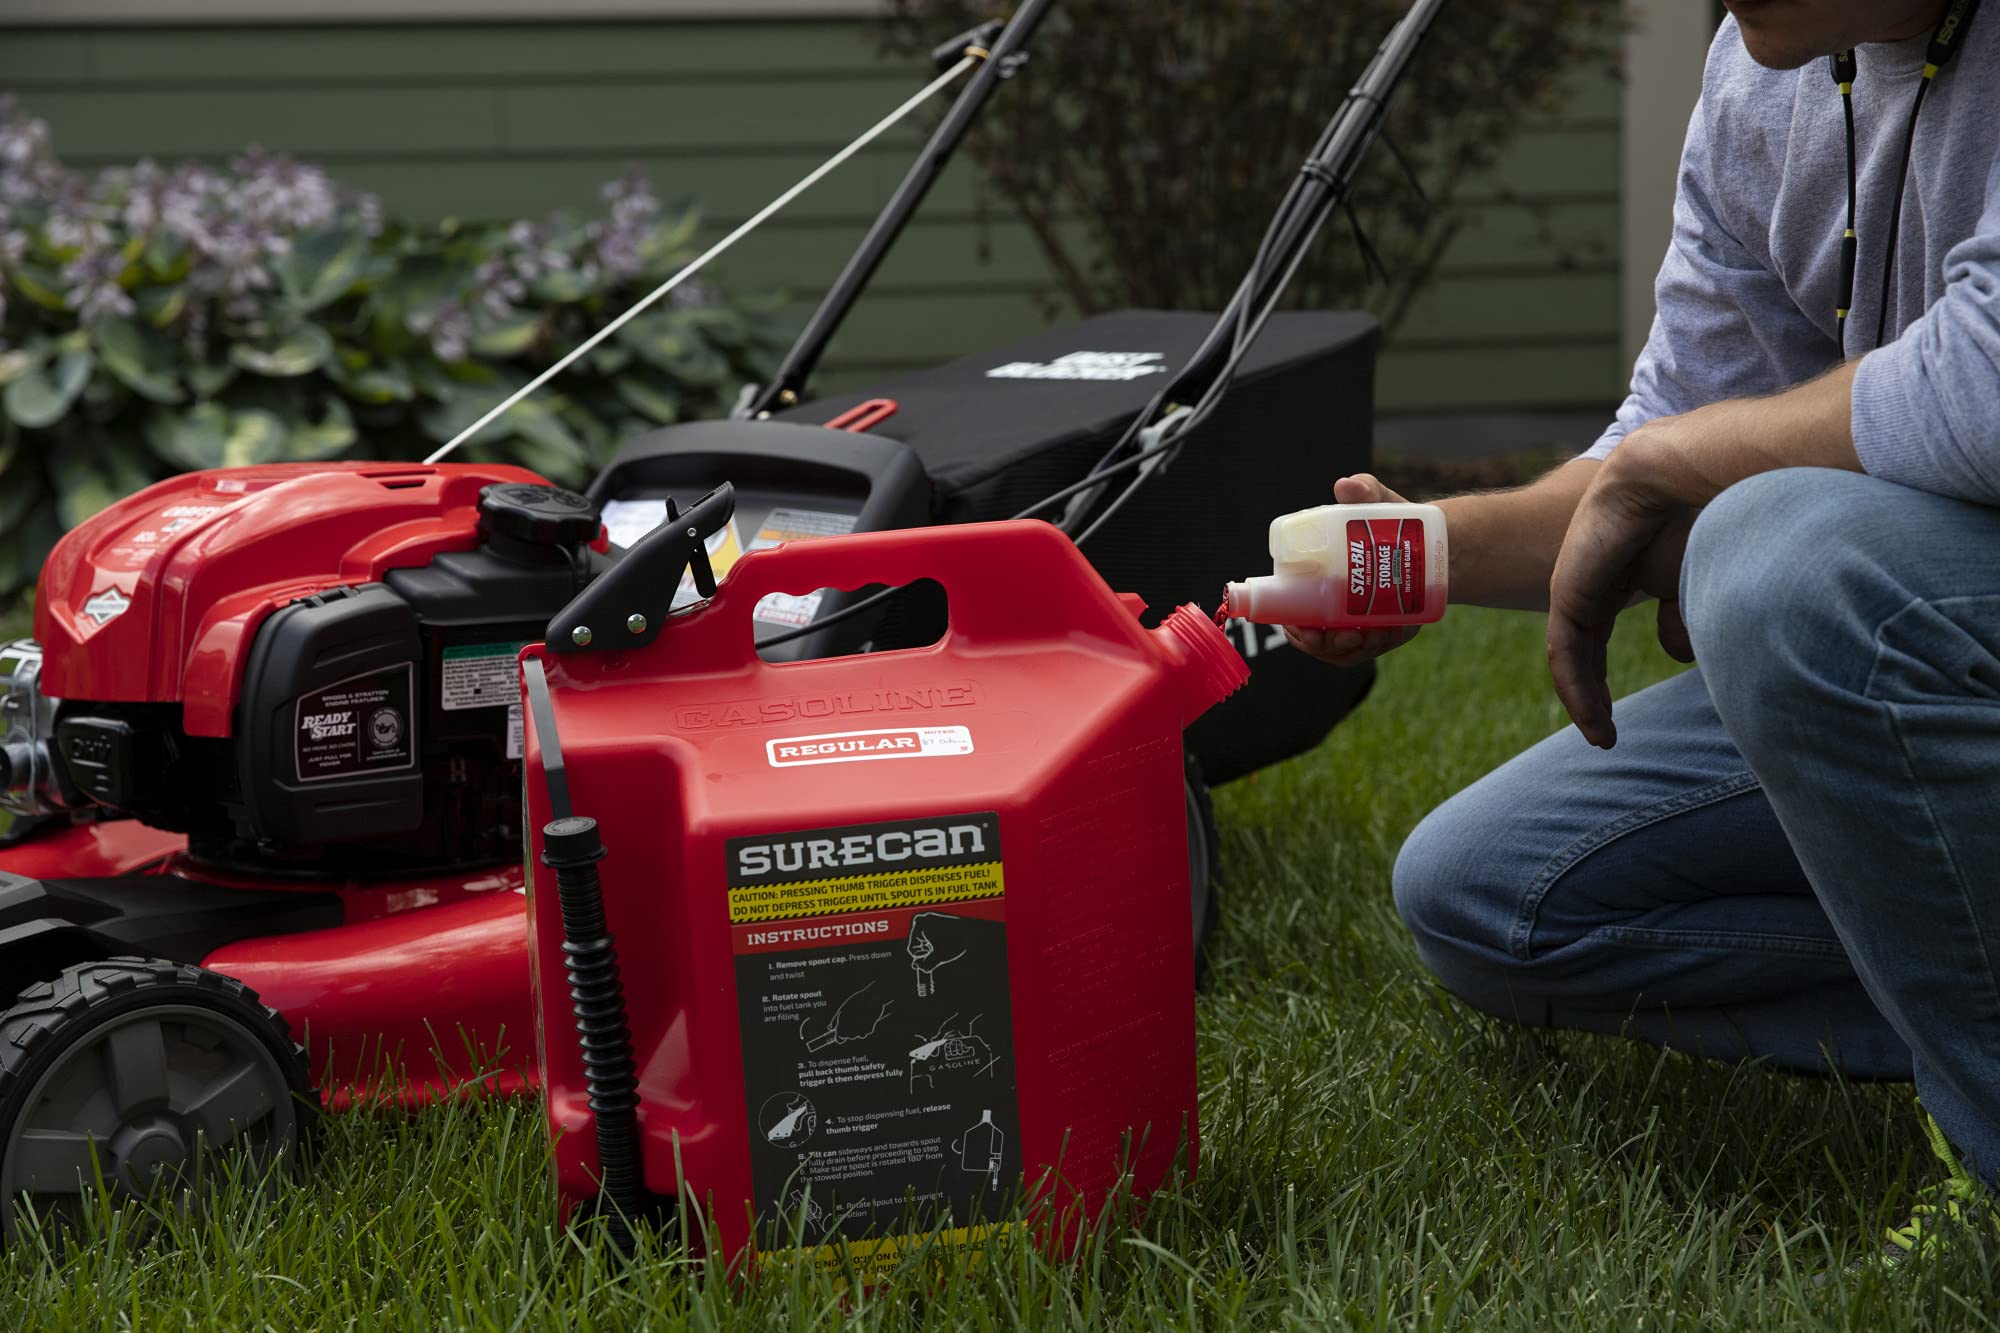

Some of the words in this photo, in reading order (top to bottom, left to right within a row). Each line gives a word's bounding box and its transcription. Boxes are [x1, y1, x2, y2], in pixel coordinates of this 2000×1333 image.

[1350, 540, 1365, 596] STA-BIL
[1379, 545, 1391, 588] STORAGE
[677, 687, 976, 729] GASOLINE
[301, 711, 352, 730] READY
[311, 723, 356, 740] START
[779, 736, 915, 758] REGULAR
[732, 891, 778, 903] CAUTION:
[780, 886, 828, 899] PRESSING
[830, 882, 865, 893] THUMB
[867, 877, 908, 889] TRIGGER
[910, 871, 962, 885] DISPENSES
[964, 869, 990, 880] FUEL!
[733, 906, 748, 916] DO
[750, 904, 770, 914] NOT
[772, 900, 816, 912] DEPRESS
[817, 896, 858, 908] TRIGGER
[860, 891, 889, 902] UNTIL
[890, 888, 924, 900] SPOUT
[924, 887, 934, 897] IS
[935, 886, 945, 895] IN
[948, 884, 970, 894] FUEL
[973, 881, 998, 891] TANK
[747, 920, 889, 946] INSTRUCTIONS
[776, 961, 807, 969] Remove
[808, 957, 831, 967] spout
[849, 953, 869, 961] Press
[871, 951, 892, 959] down
[769, 972, 784, 981] and
[785, 971, 805, 980] twist
[772, 993, 799, 1002] Rotate
[800, 990, 822, 1000] spout
[763, 1004, 778, 1012] into
[779, 1002, 794, 1011] fuel
[795, 1001, 812, 1009] tank
[813, 1000, 827, 1009] you
[778, 1013, 800, 1022] filling
[799, 1070, 814, 1079] pull
[815, 1068, 834, 1076] back
[834, 1065, 859, 1074] thumb
[860, 1063, 885, 1071] safety
[808, 1060, 817, 1068] To
[818, 1057, 852, 1068] dispense
[929, 1058, 981, 1071] GASOLINE
[800, 1078, 826, 1088] trigger
[834, 1075, 853, 1083] then
[854, 1071, 885, 1081] depress
[885, 1069, 903, 1077] fully
[837, 1116, 846, 1124] To
[847, 1115, 864, 1123] stop
[865, 1109, 905, 1121] dispensing
[922, 1104, 951, 1113] release
[825, 1125, 851, 1135] thumb
[852, 1123, 879, 1132] trigger
[823, 1150, 836, 1158] can
[838, 1145, 873, 1156] sideways
[874, 1143, 888, 1151] and
[889, 1140, 919, 1149] towards
[920, 1137, 941, 1146] spout
[826, 1157, 846, 1165] drain
[847, 1154, 871, 1163] before
[872, 1149, 912, 1161] proceeding
[922, 1145, 939, 1153] step
[810, 1166, 830, 1174] Make
[831, 1164, 848, 1172] sure
[849, 1161, 870, 1170] spout
[879, 1156, 906, 1166] rotated
[925, 1152, 943, 1160] from
[800, 1175, 813, 1183] the
[814, 1172, 841, 1182] stowed
[846, 1201, 871, 1210] Rotate
[873, 1198, 893, 1207] spout
[904, 1195, 915, 1203] te
